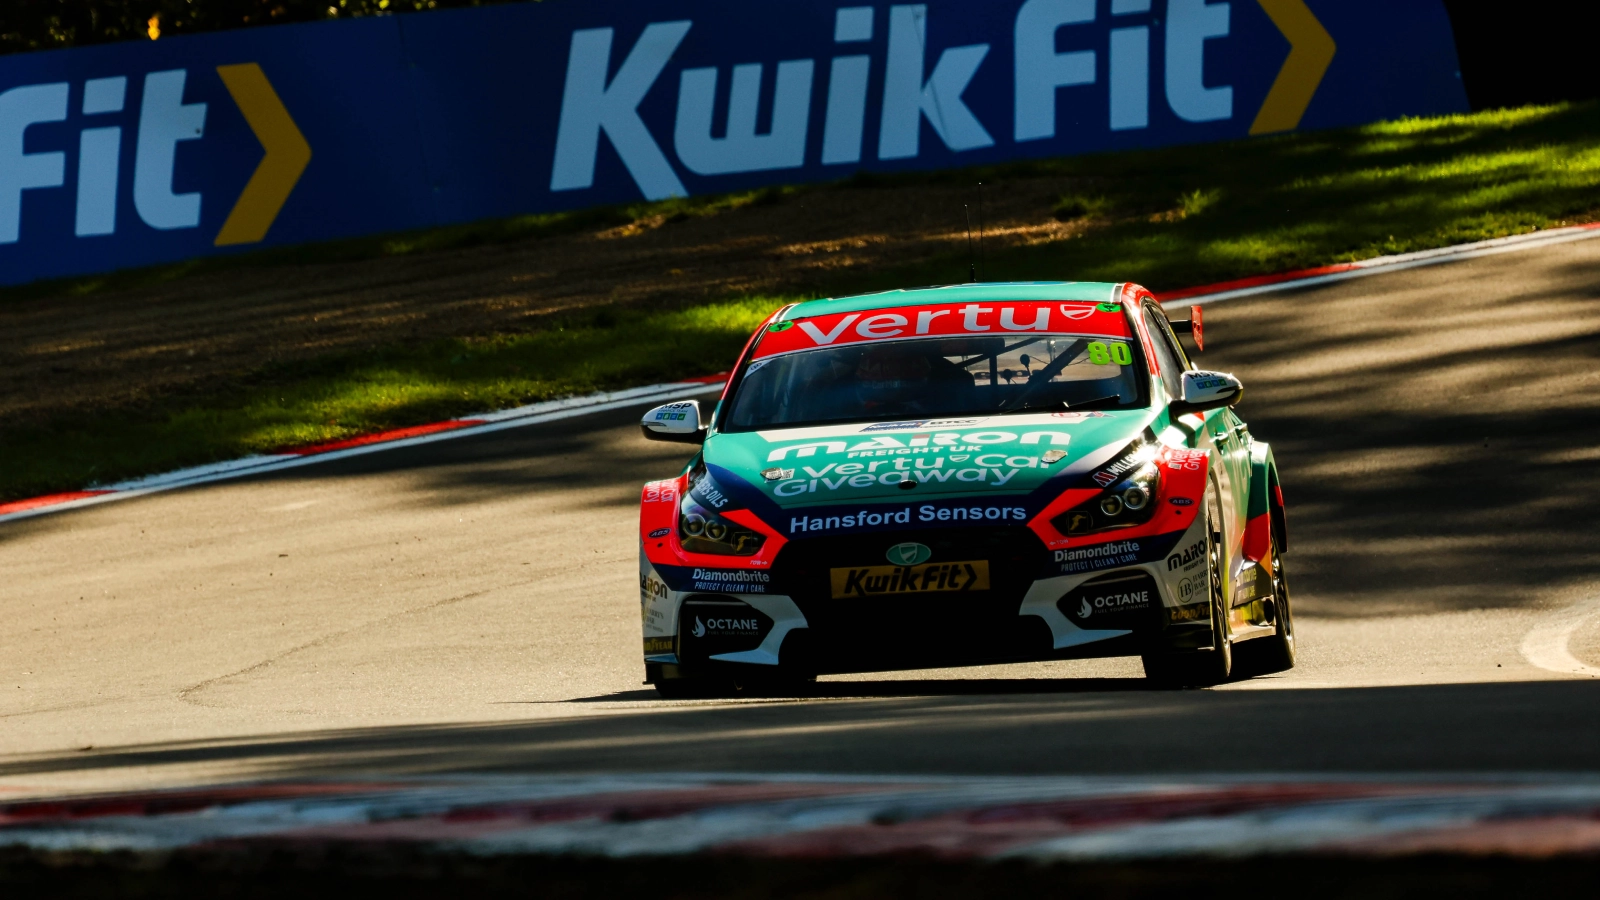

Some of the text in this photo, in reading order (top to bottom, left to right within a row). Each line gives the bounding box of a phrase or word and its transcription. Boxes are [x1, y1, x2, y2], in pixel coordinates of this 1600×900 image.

[1087, 341, 1132, 366] 80
[847, 444, 983, 458] FREIGHT UK
[706, 490, 728, 508] OILS
[790, 504, 1027, 533] Hansford Sensors
[1054, 541, 1140, 563] Diamondbrite
[1061, 553, 1138, 572] PROTECT CLEAN CARE
[692, 568, 770, 583] Diamondbrite
[694, 582, 765, 593] PROTECT CLEAN CARE
[1094, 590, 1149, 608] OCTANE
[1126, 603, 1150, 611] FINANCE
[707, 618, 759, 630] OCTANE
